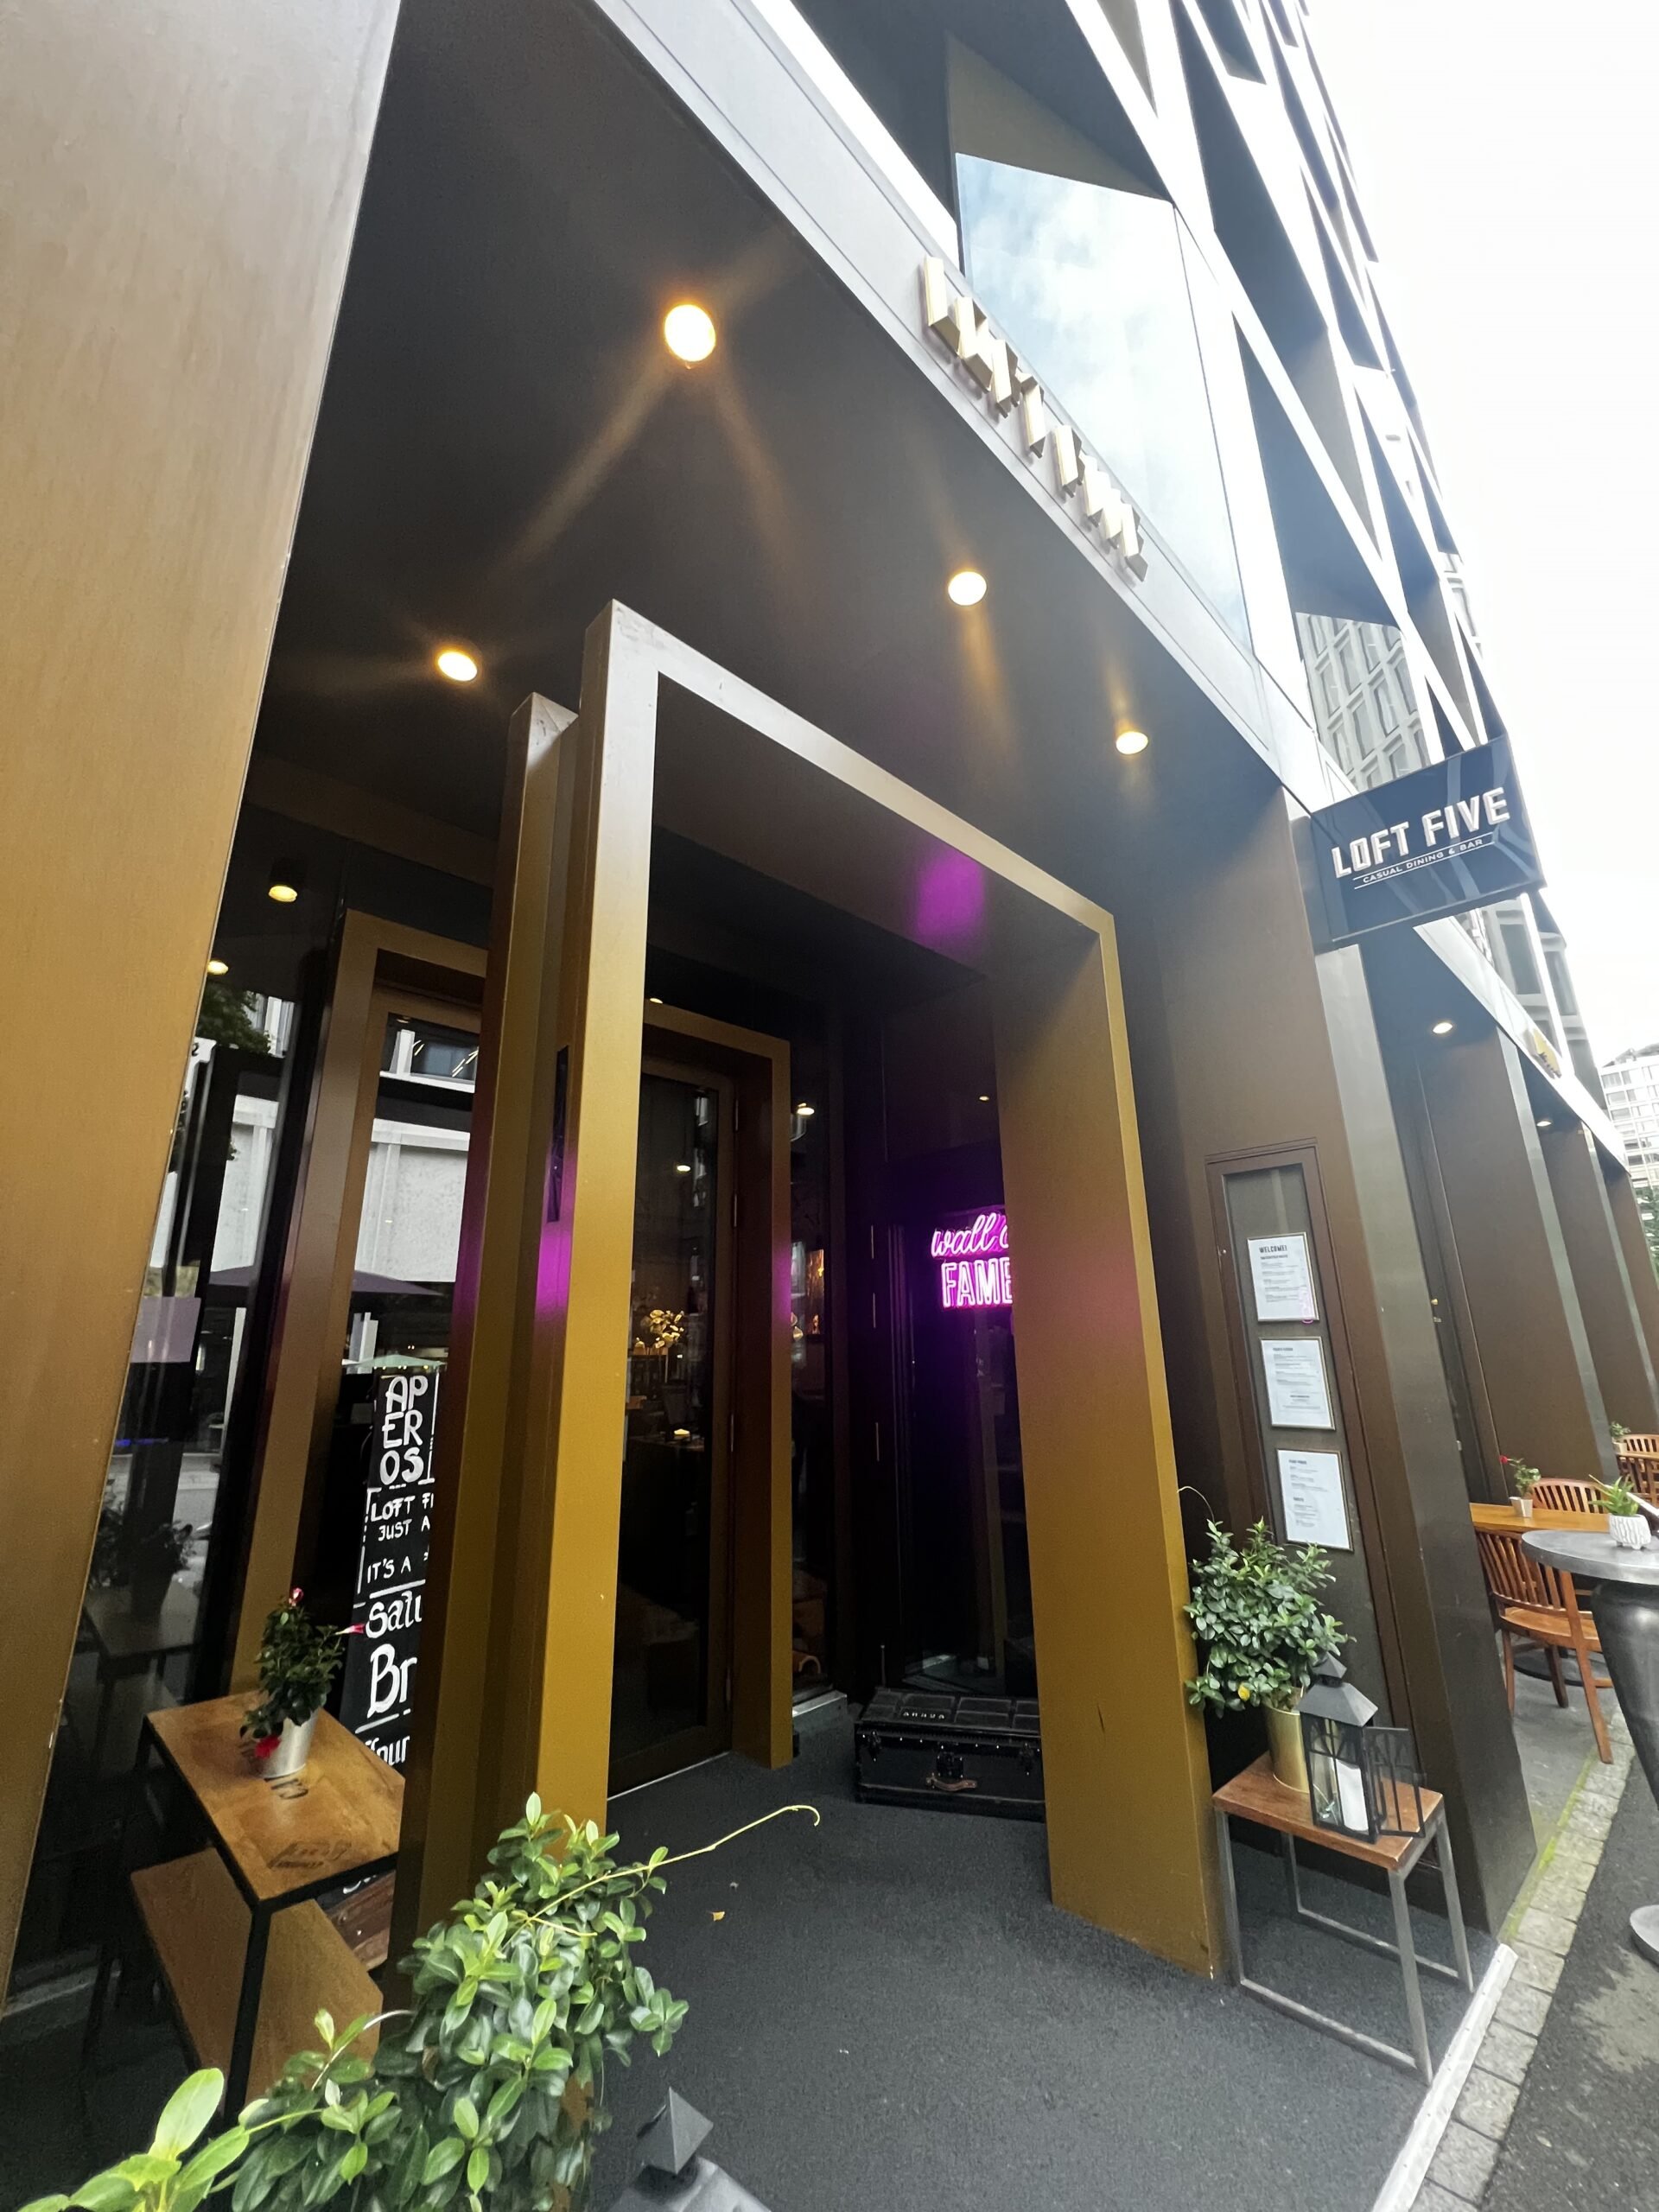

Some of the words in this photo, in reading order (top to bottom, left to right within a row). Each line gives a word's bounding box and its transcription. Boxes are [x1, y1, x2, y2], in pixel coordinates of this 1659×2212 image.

[1332, 821, 1409, 879] LOFT
[1421, 787, 1510, 847] FIVE
[1363, 867, 1403, 884] CASUAL
[1406, 851, 1444, 869] DINING
[1459, 838, 1484, 851] BAR
[931, 1212, 1000, 1258] wall
[941, 1256, 1013, 1308] FAME
[371, 1495, 416, 1522] LOFT
[378, 1519, 413, 1541] JUST
[421, 1515, 431, 1532] A
[367, 1558, 395, 1584] IT'S
[400, 1555, 412, 1574] A
[366, 1643, 418, 1719] Br
